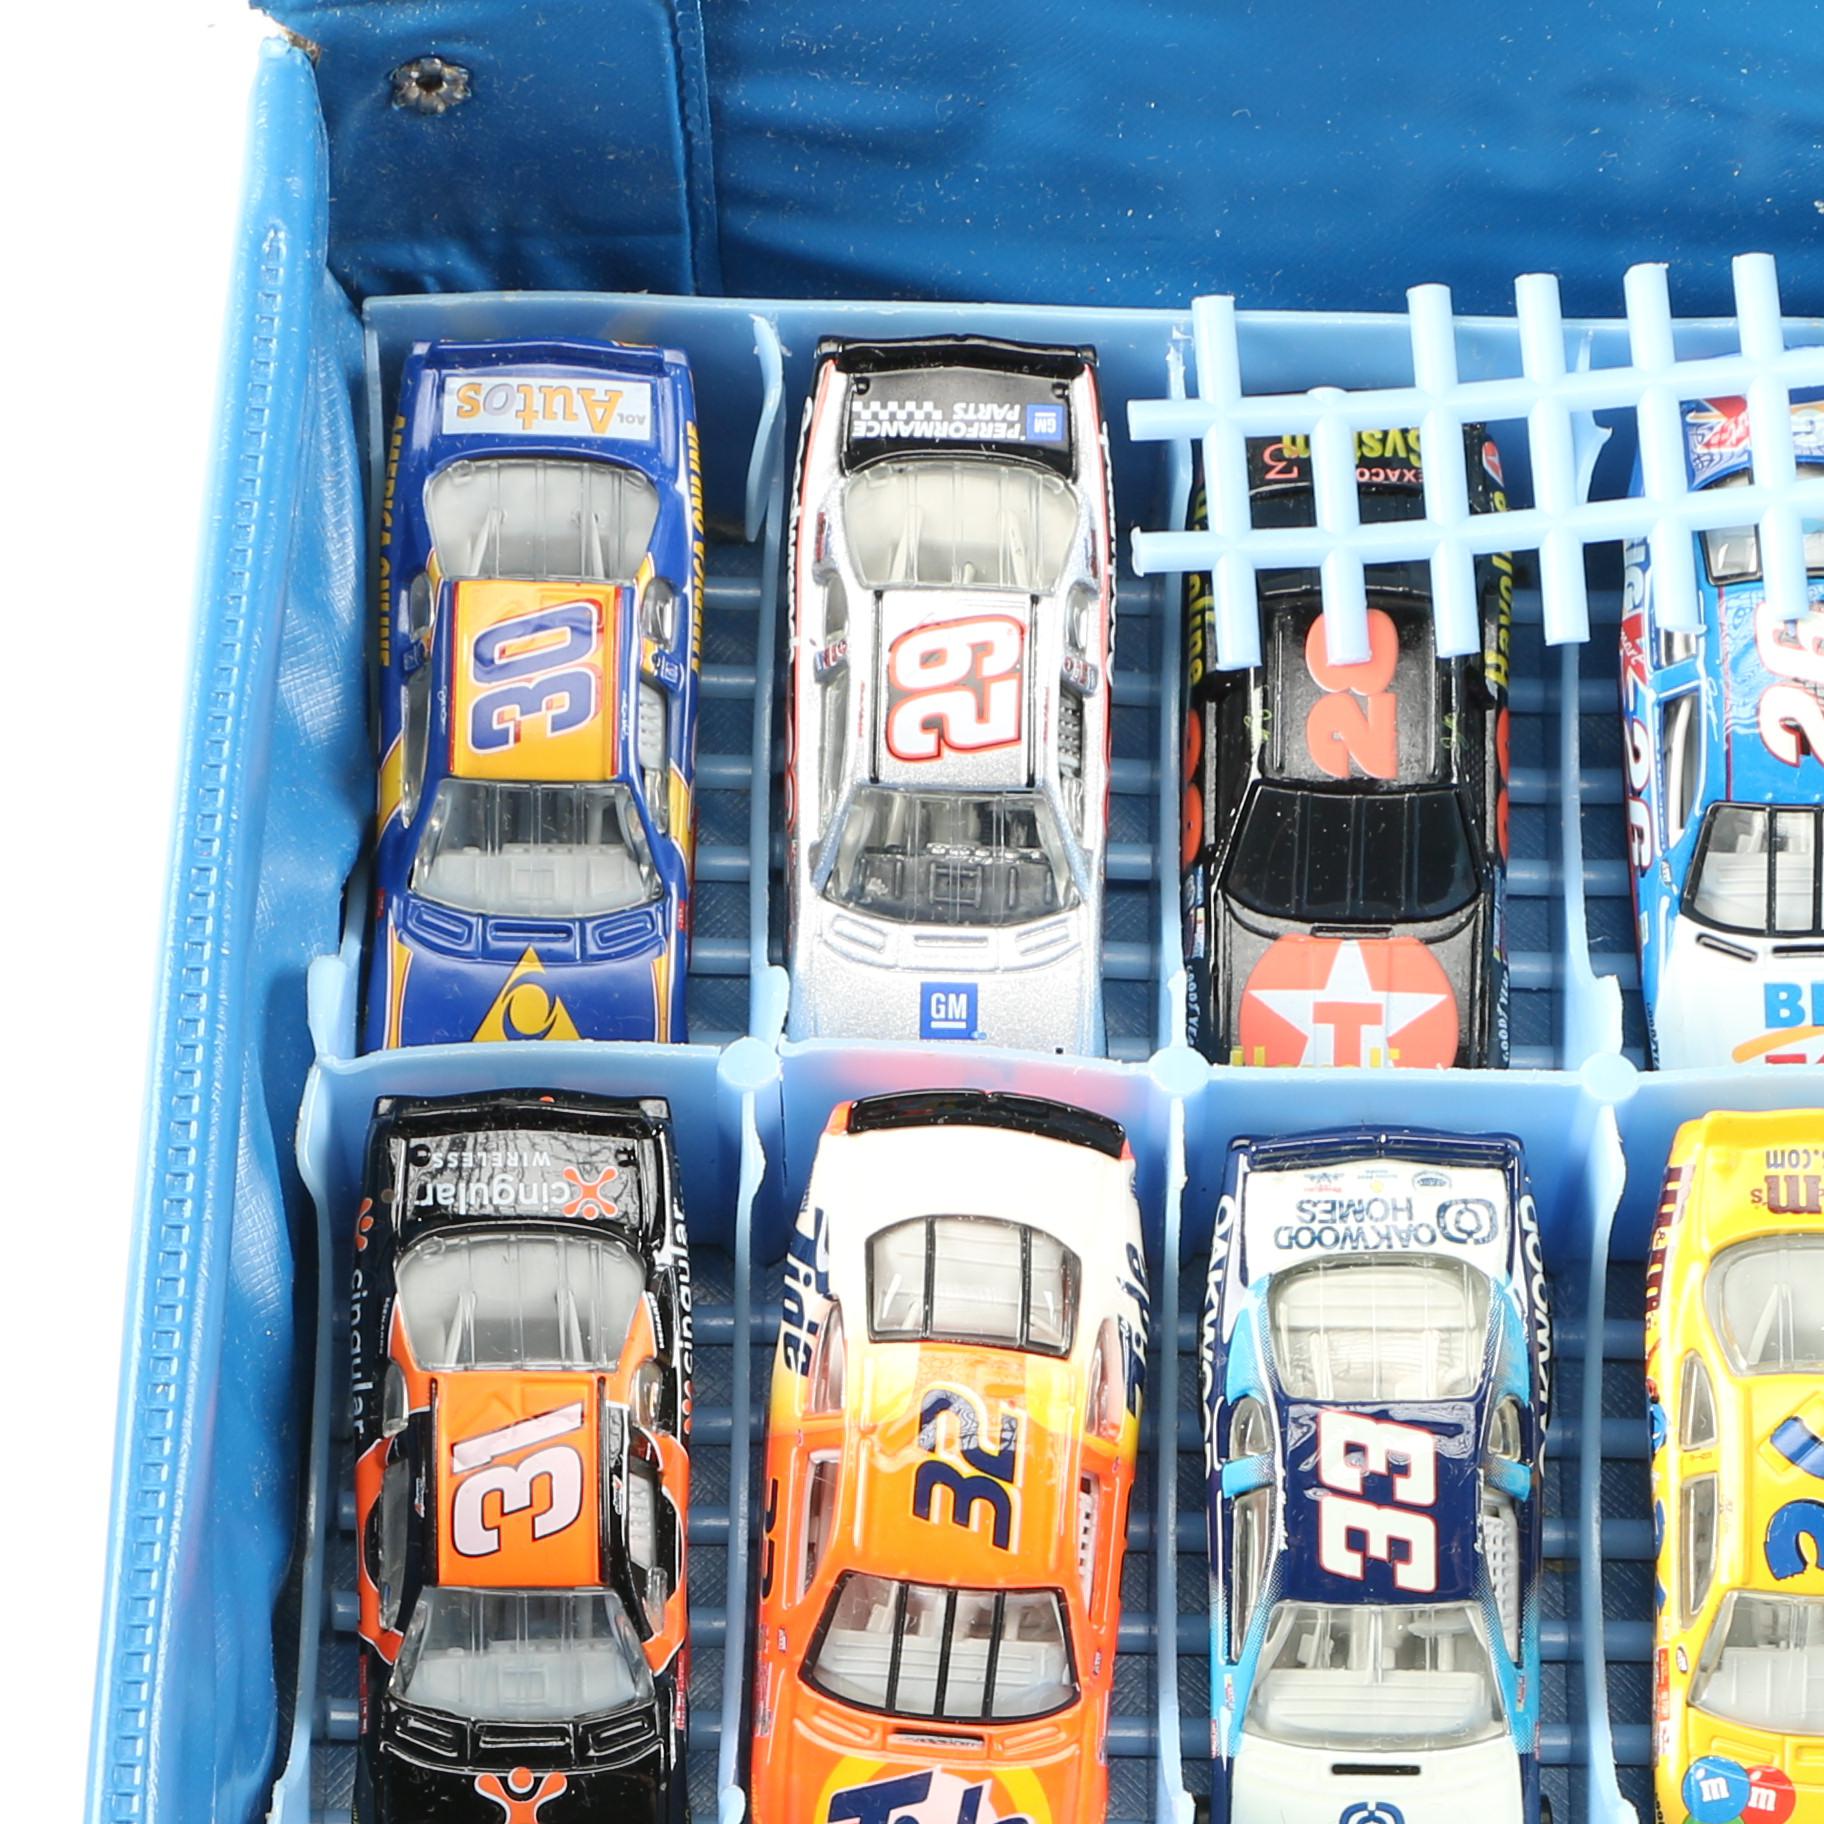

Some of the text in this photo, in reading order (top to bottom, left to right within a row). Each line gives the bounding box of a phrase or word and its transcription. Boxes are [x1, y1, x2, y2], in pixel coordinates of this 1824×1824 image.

[456, 381, 647, 435] AOL Autos
[952, 402, 1021, 422] PARTS
[1033, 419, 1057, 434] GM
[853, 419, 1026, 441] PERFORMANCE
[470, 598, 603, 753] 30
[887, 612, 1029, 762] 29
[1305, 607, 1399, 780] 28
[929, 991, 968, 1021] GM
[432, 1150, 552, 1168] WIRELESS
[415, 1172, 572, 1216] cingular
[1296, 1197, 1415, 1225] HOMES
[1274, 1224, 1438, 1251] OAKWOOD
[782, 1206, 831, 1378] Tide
[451, 1402, 585, 1557] 31
[912, 1385, 1020, 1552] 32
[1316, 1407, 1439, 1594] 33
[1699, 1775, 1730, 1803] m
[1747, 1784, 1777, 1813] m
